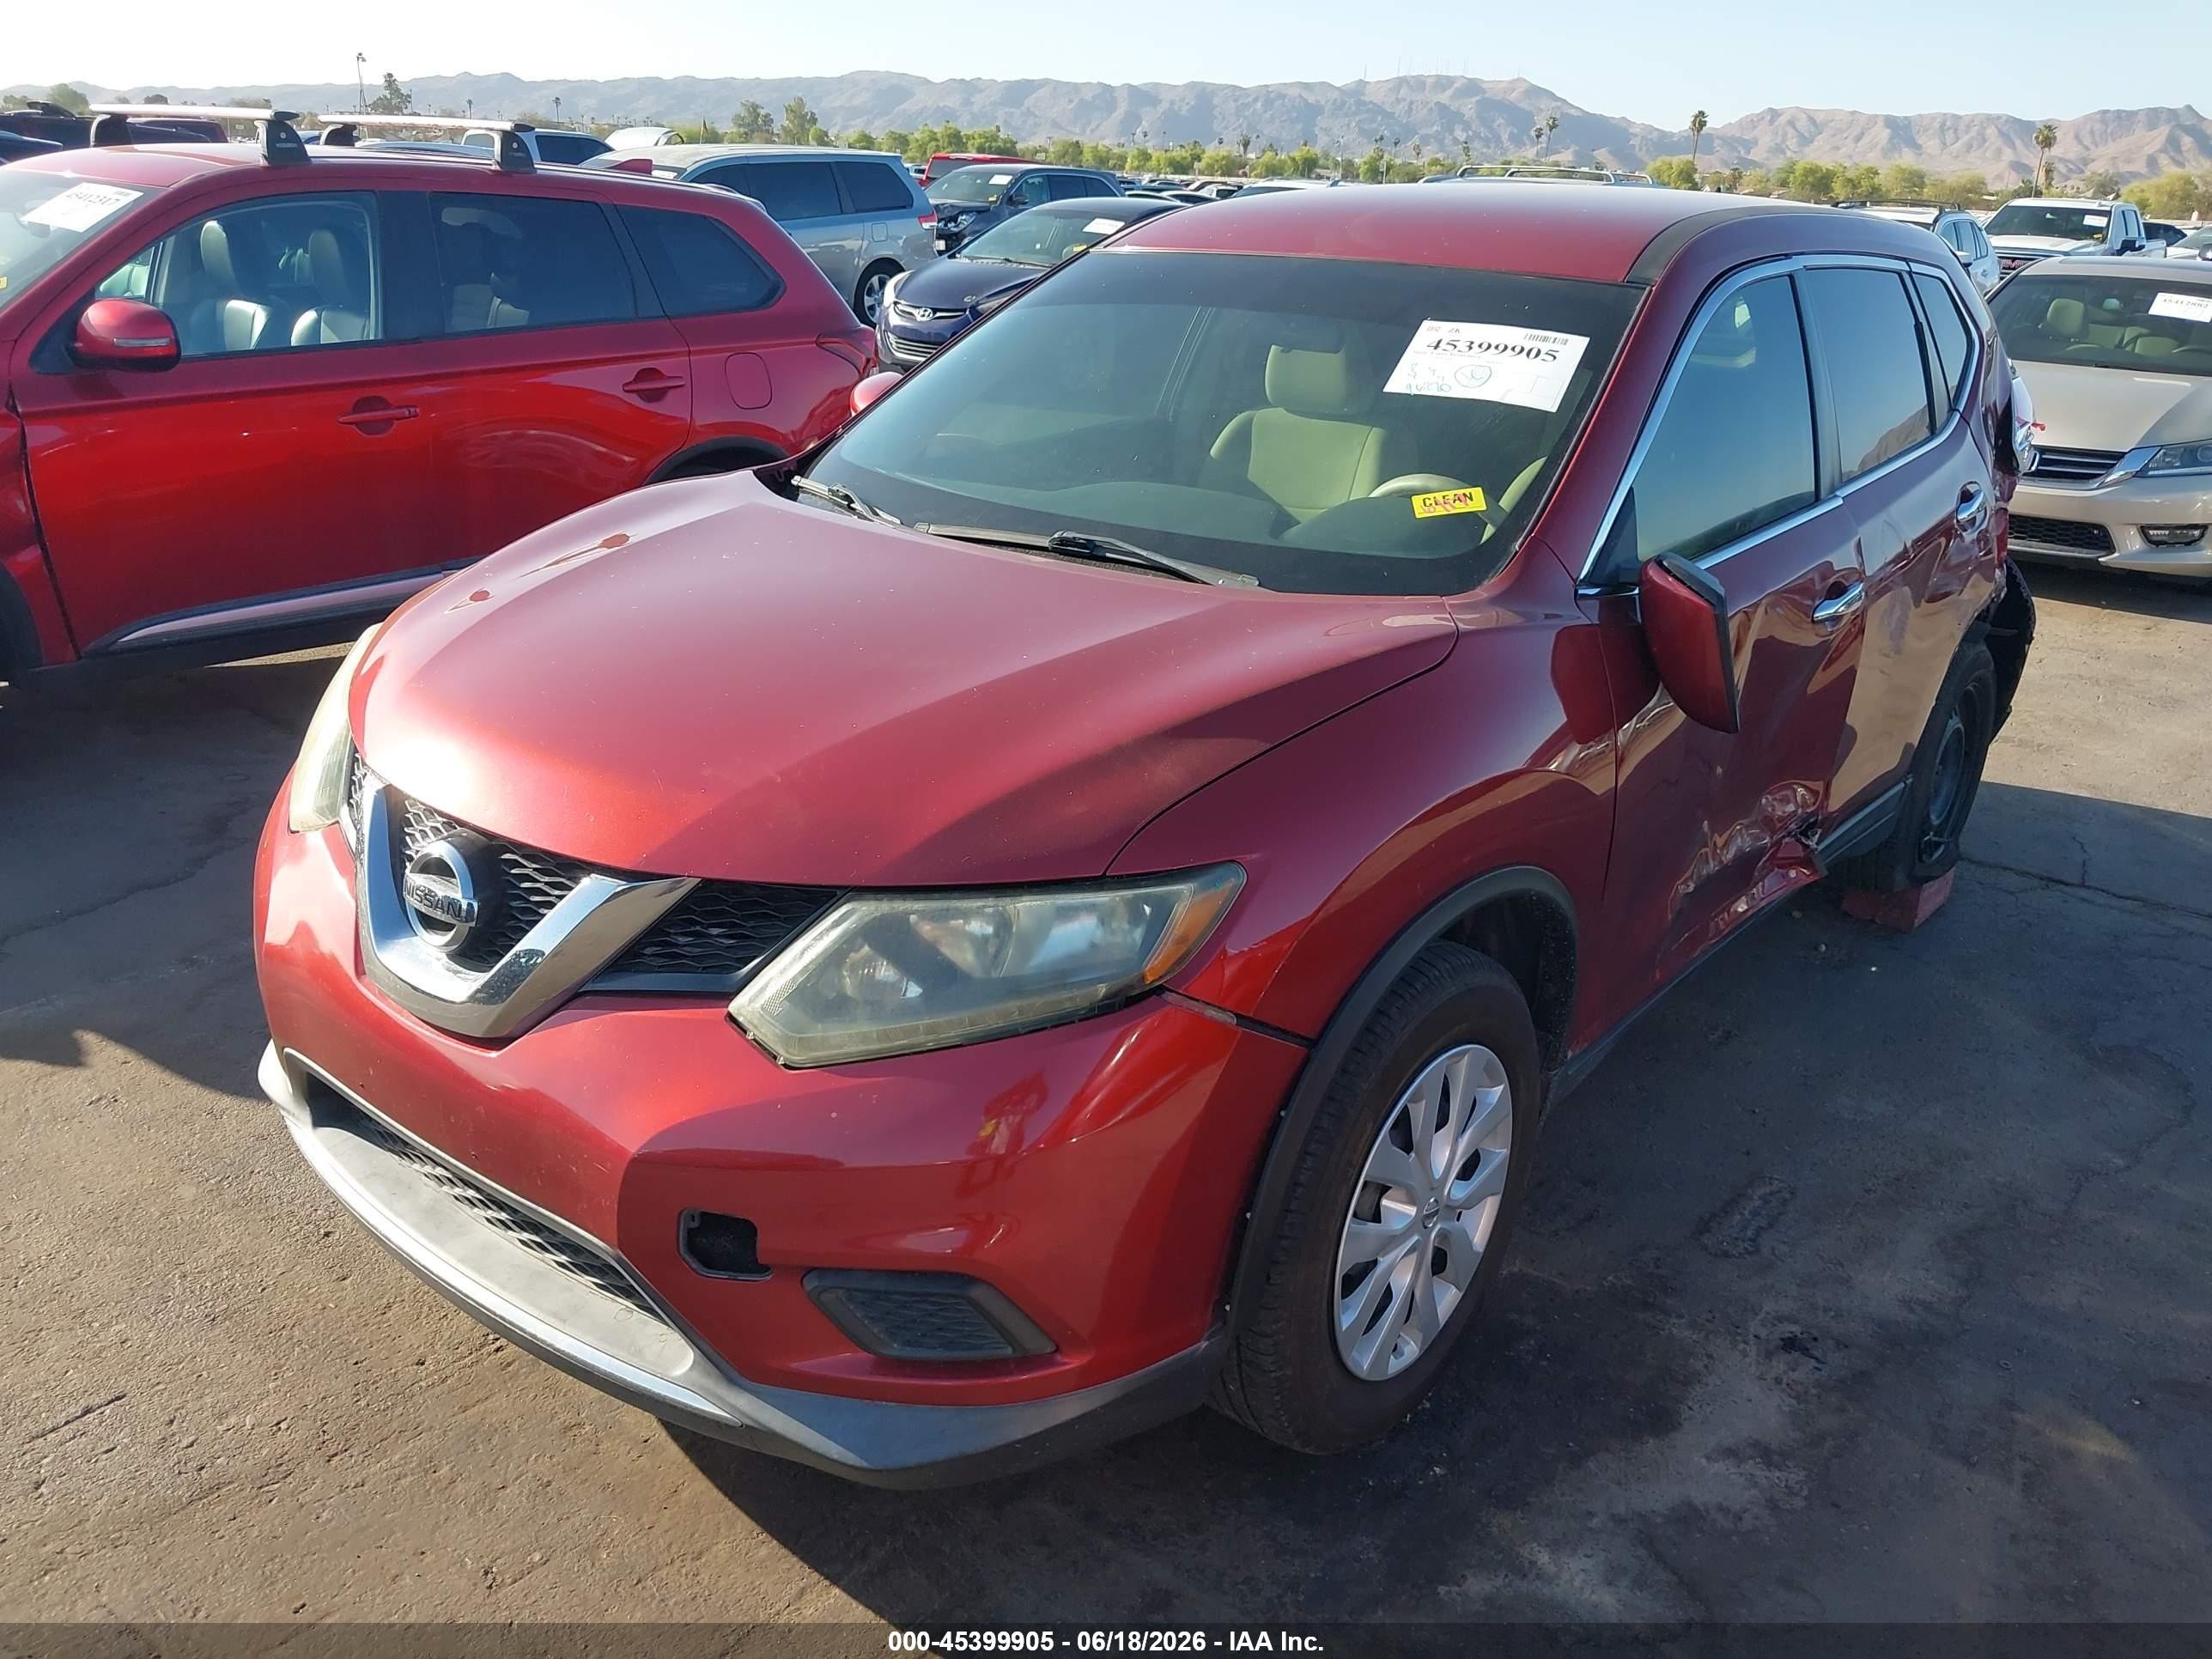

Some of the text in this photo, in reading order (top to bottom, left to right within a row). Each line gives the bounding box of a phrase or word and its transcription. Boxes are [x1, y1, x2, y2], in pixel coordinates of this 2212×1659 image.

[1425, 337, 1560, 363] 45399905
[1421, 491, 1474, 507] CLEAN
[404, 877, 464, 921] NISSAN
